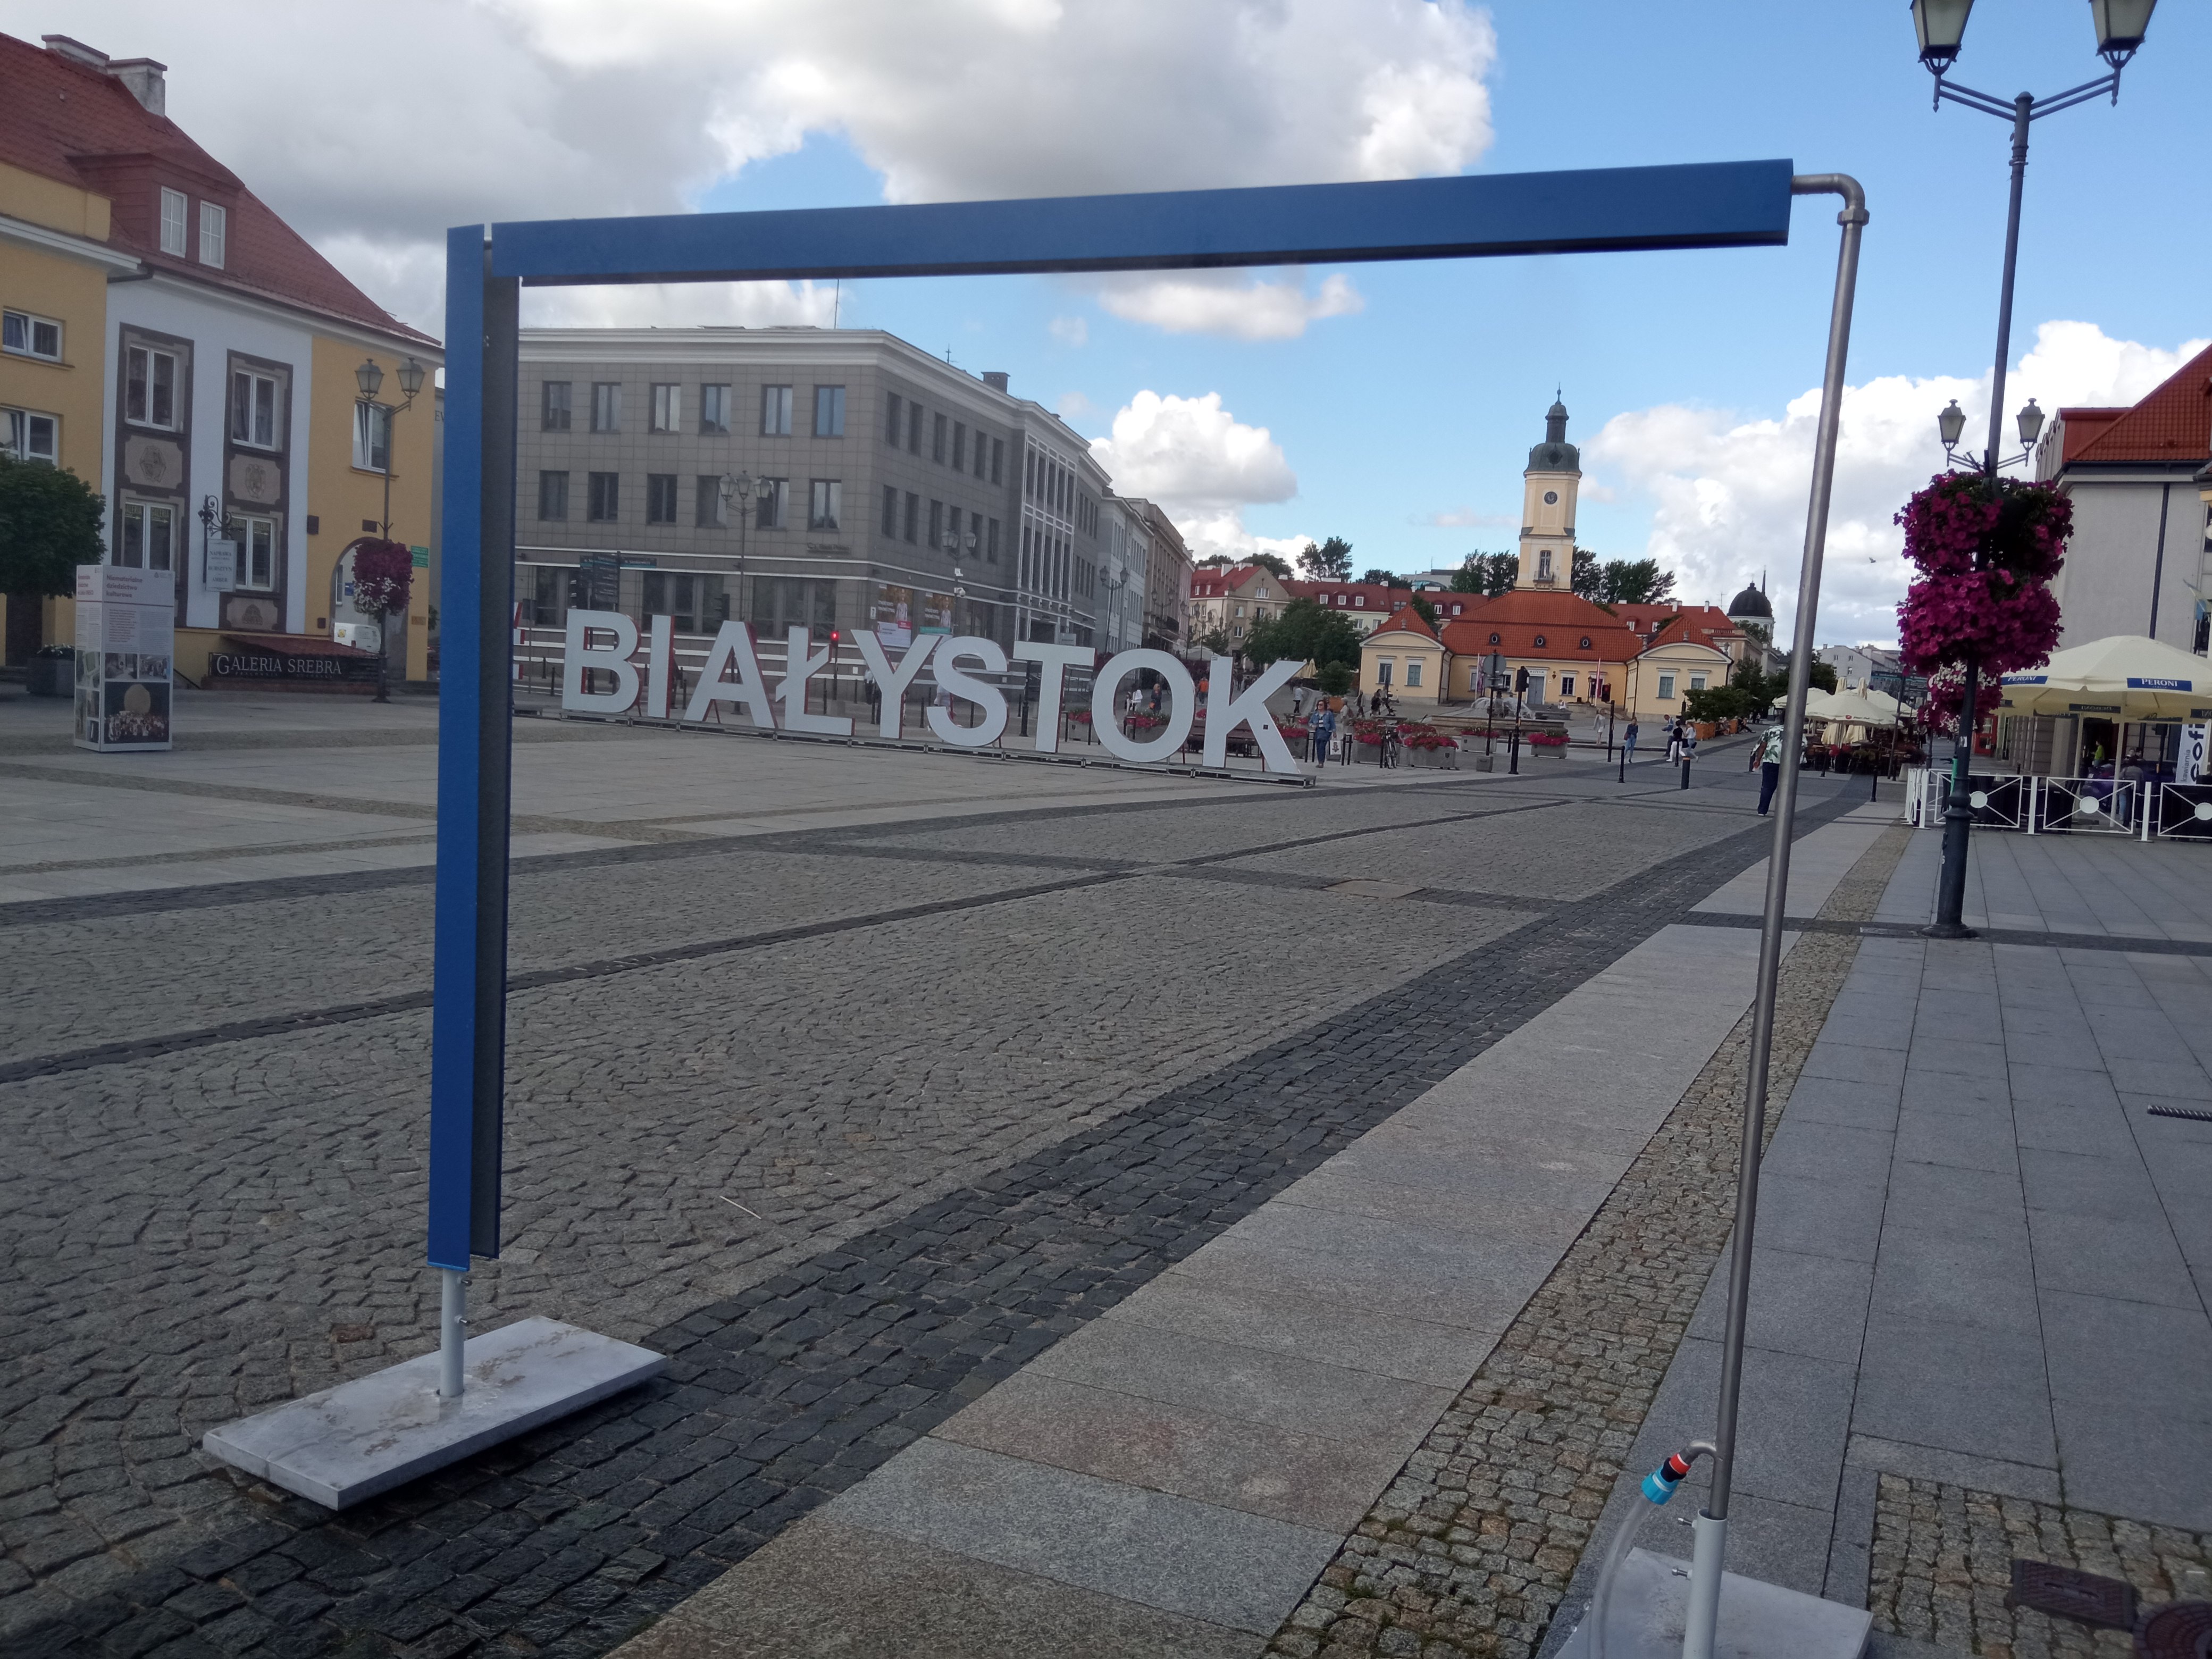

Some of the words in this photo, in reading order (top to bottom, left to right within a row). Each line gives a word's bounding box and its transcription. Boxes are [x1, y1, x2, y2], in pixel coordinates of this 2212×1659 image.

[107, 575, 143, 583] Niematerialne
[217, 655, 282, 674] GALERIA
[288, 659, 342, 674] SREBRA
[562, 609, 1305, 774] BIAŁYSTOK
[2181, 749, 2191, 782] kawiarnia
